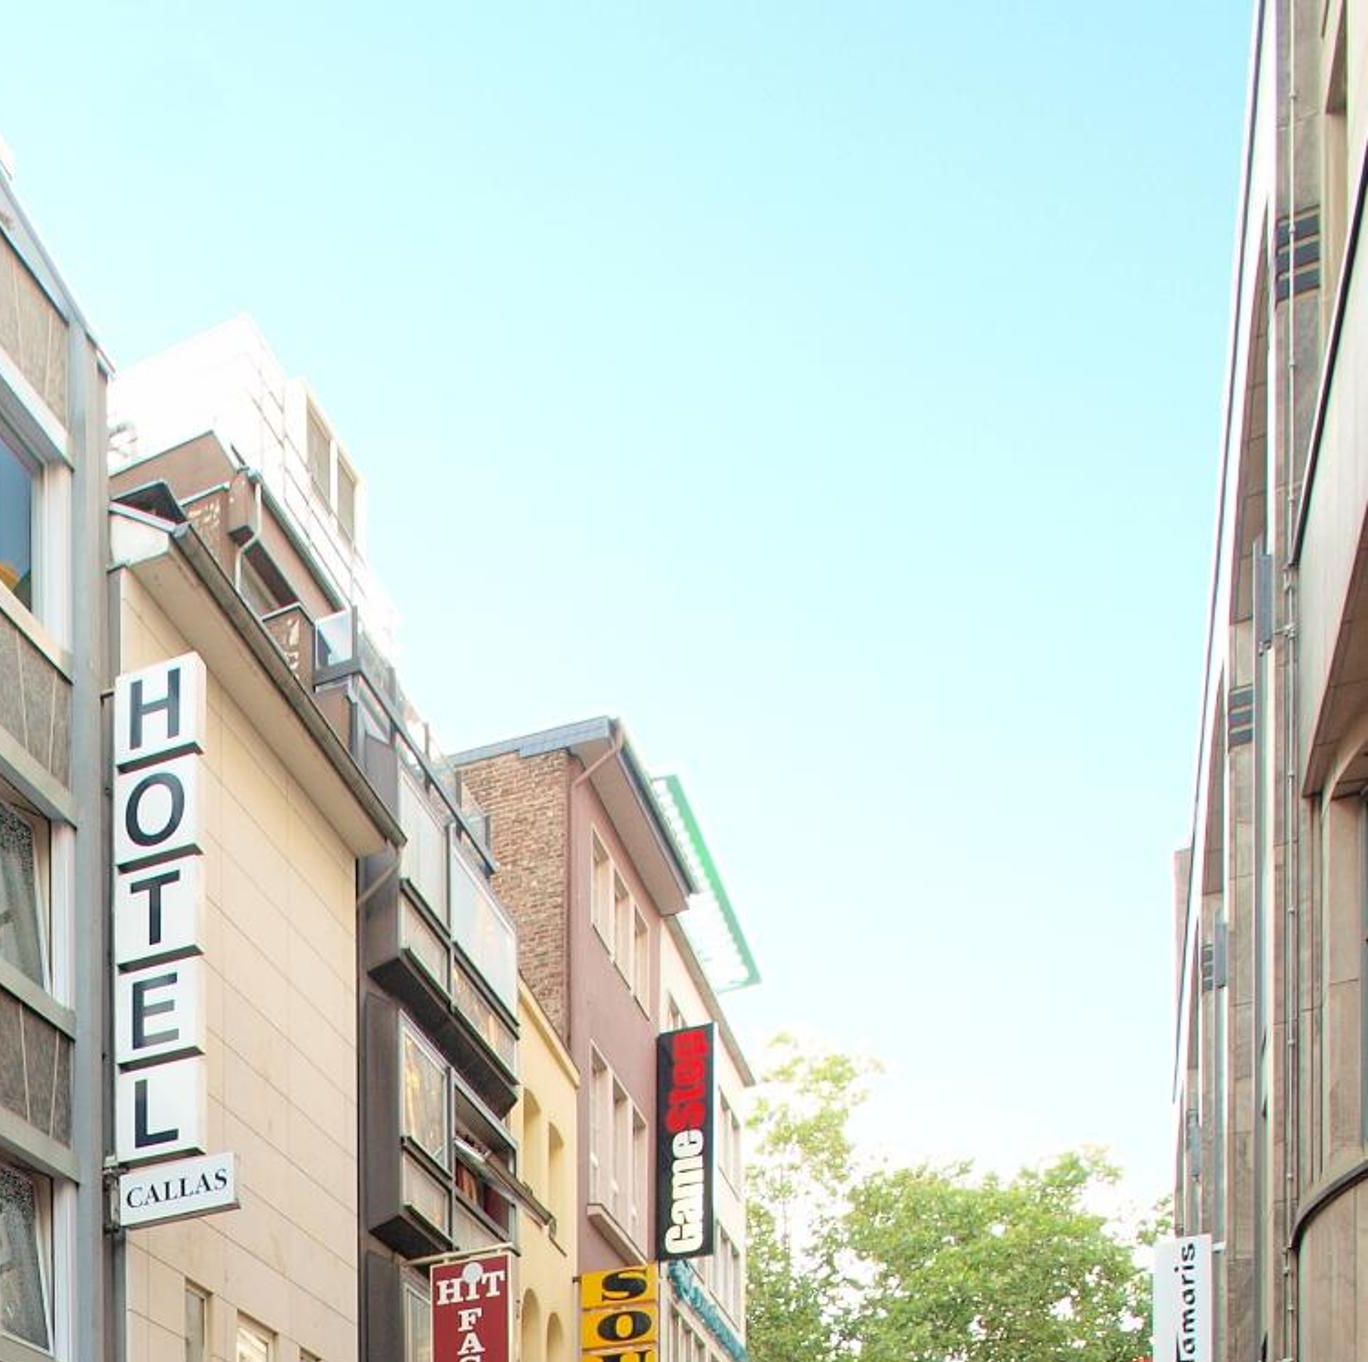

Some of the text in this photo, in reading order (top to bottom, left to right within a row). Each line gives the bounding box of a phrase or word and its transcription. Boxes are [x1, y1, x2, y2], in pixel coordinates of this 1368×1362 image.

[125, 668, 184, 1149] HOTEL
[125, 1168, 228, 1209] CALLAS
[436, 1265, 505, 1306] HIT
